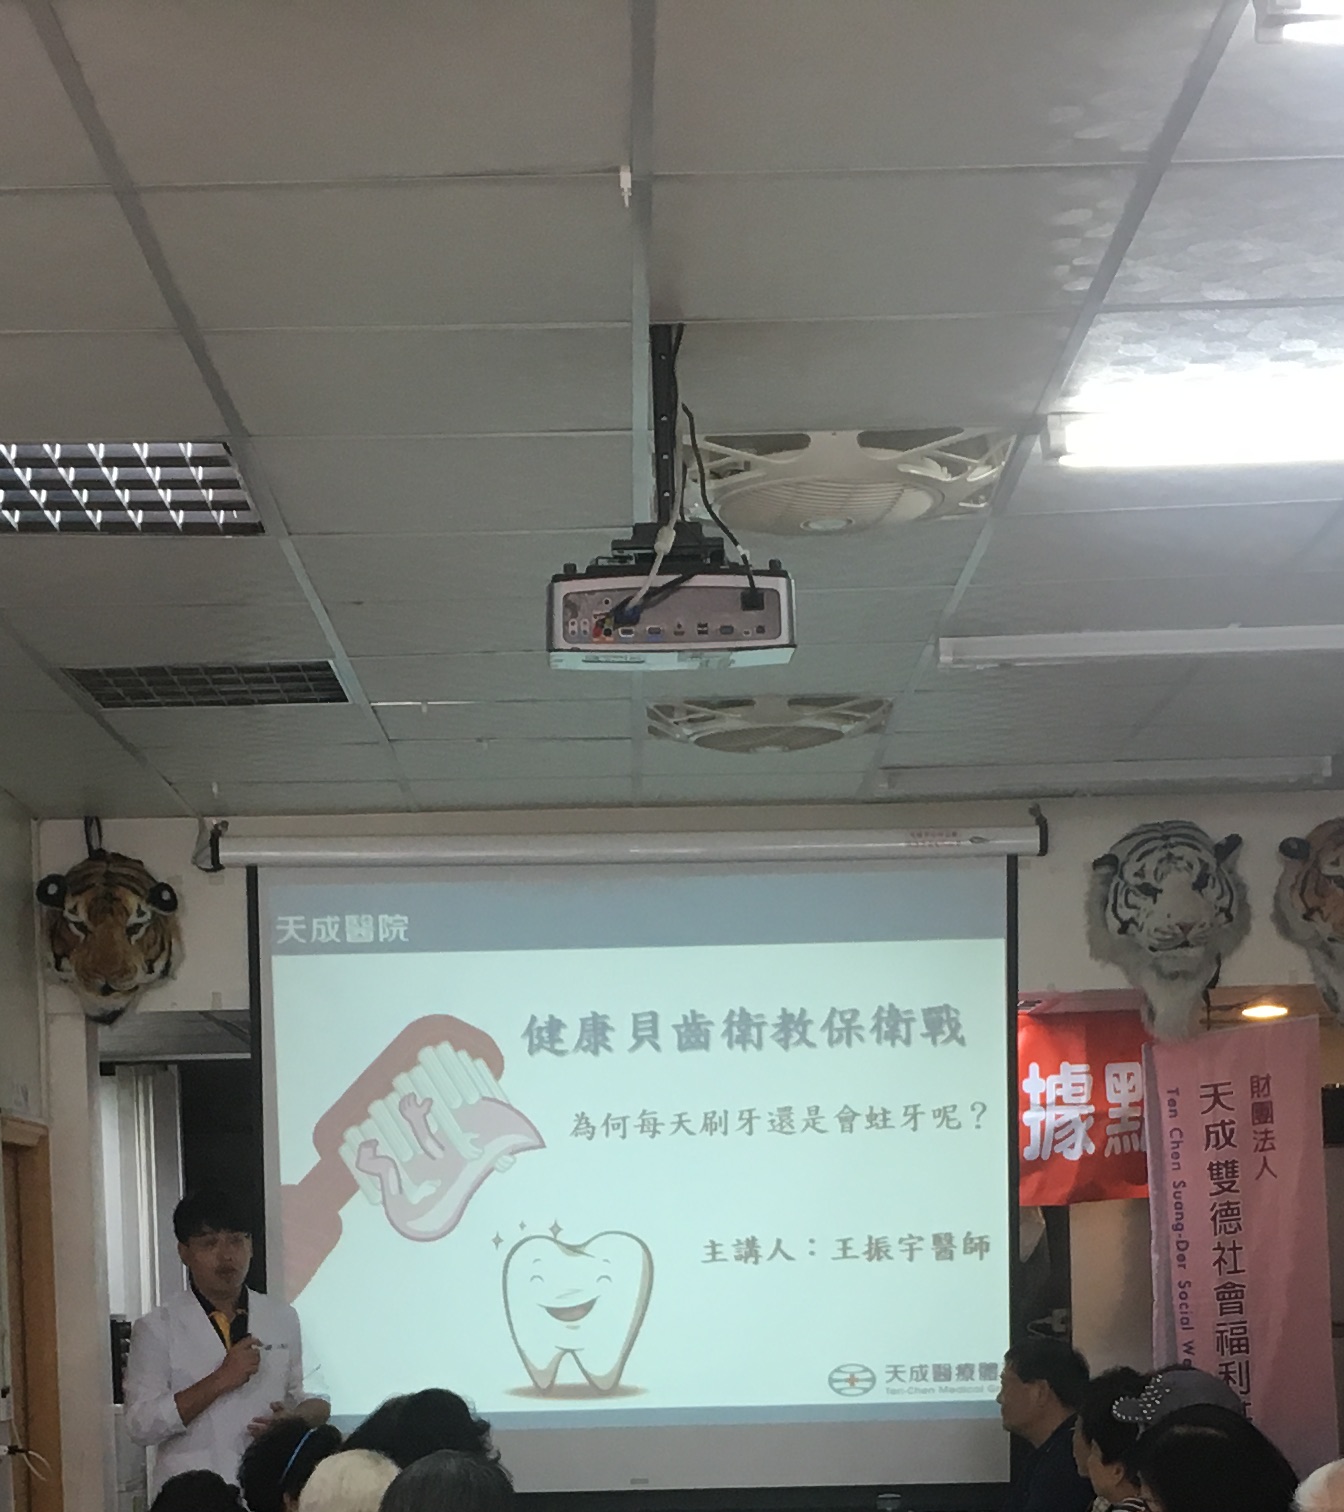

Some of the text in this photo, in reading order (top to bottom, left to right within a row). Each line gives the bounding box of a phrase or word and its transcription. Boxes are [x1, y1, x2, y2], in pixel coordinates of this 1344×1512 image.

[275, 913, 410, 945] 天成醫院
[520, 1002, 968, 1057] 健康貝齒衛教保衛戰
[1166, 1087, 1180, 1119] Ten
[1249, 1073, 1278, 1181] 財團法人
[1169, 1127, 1184, 1171] Chen
[1171, 1180, 1190, 1269] Suang-Der
[1199, 1081, 1253, 1422] 天成雙德社會福利
[1177, 1280, 1195, 1331] Social
